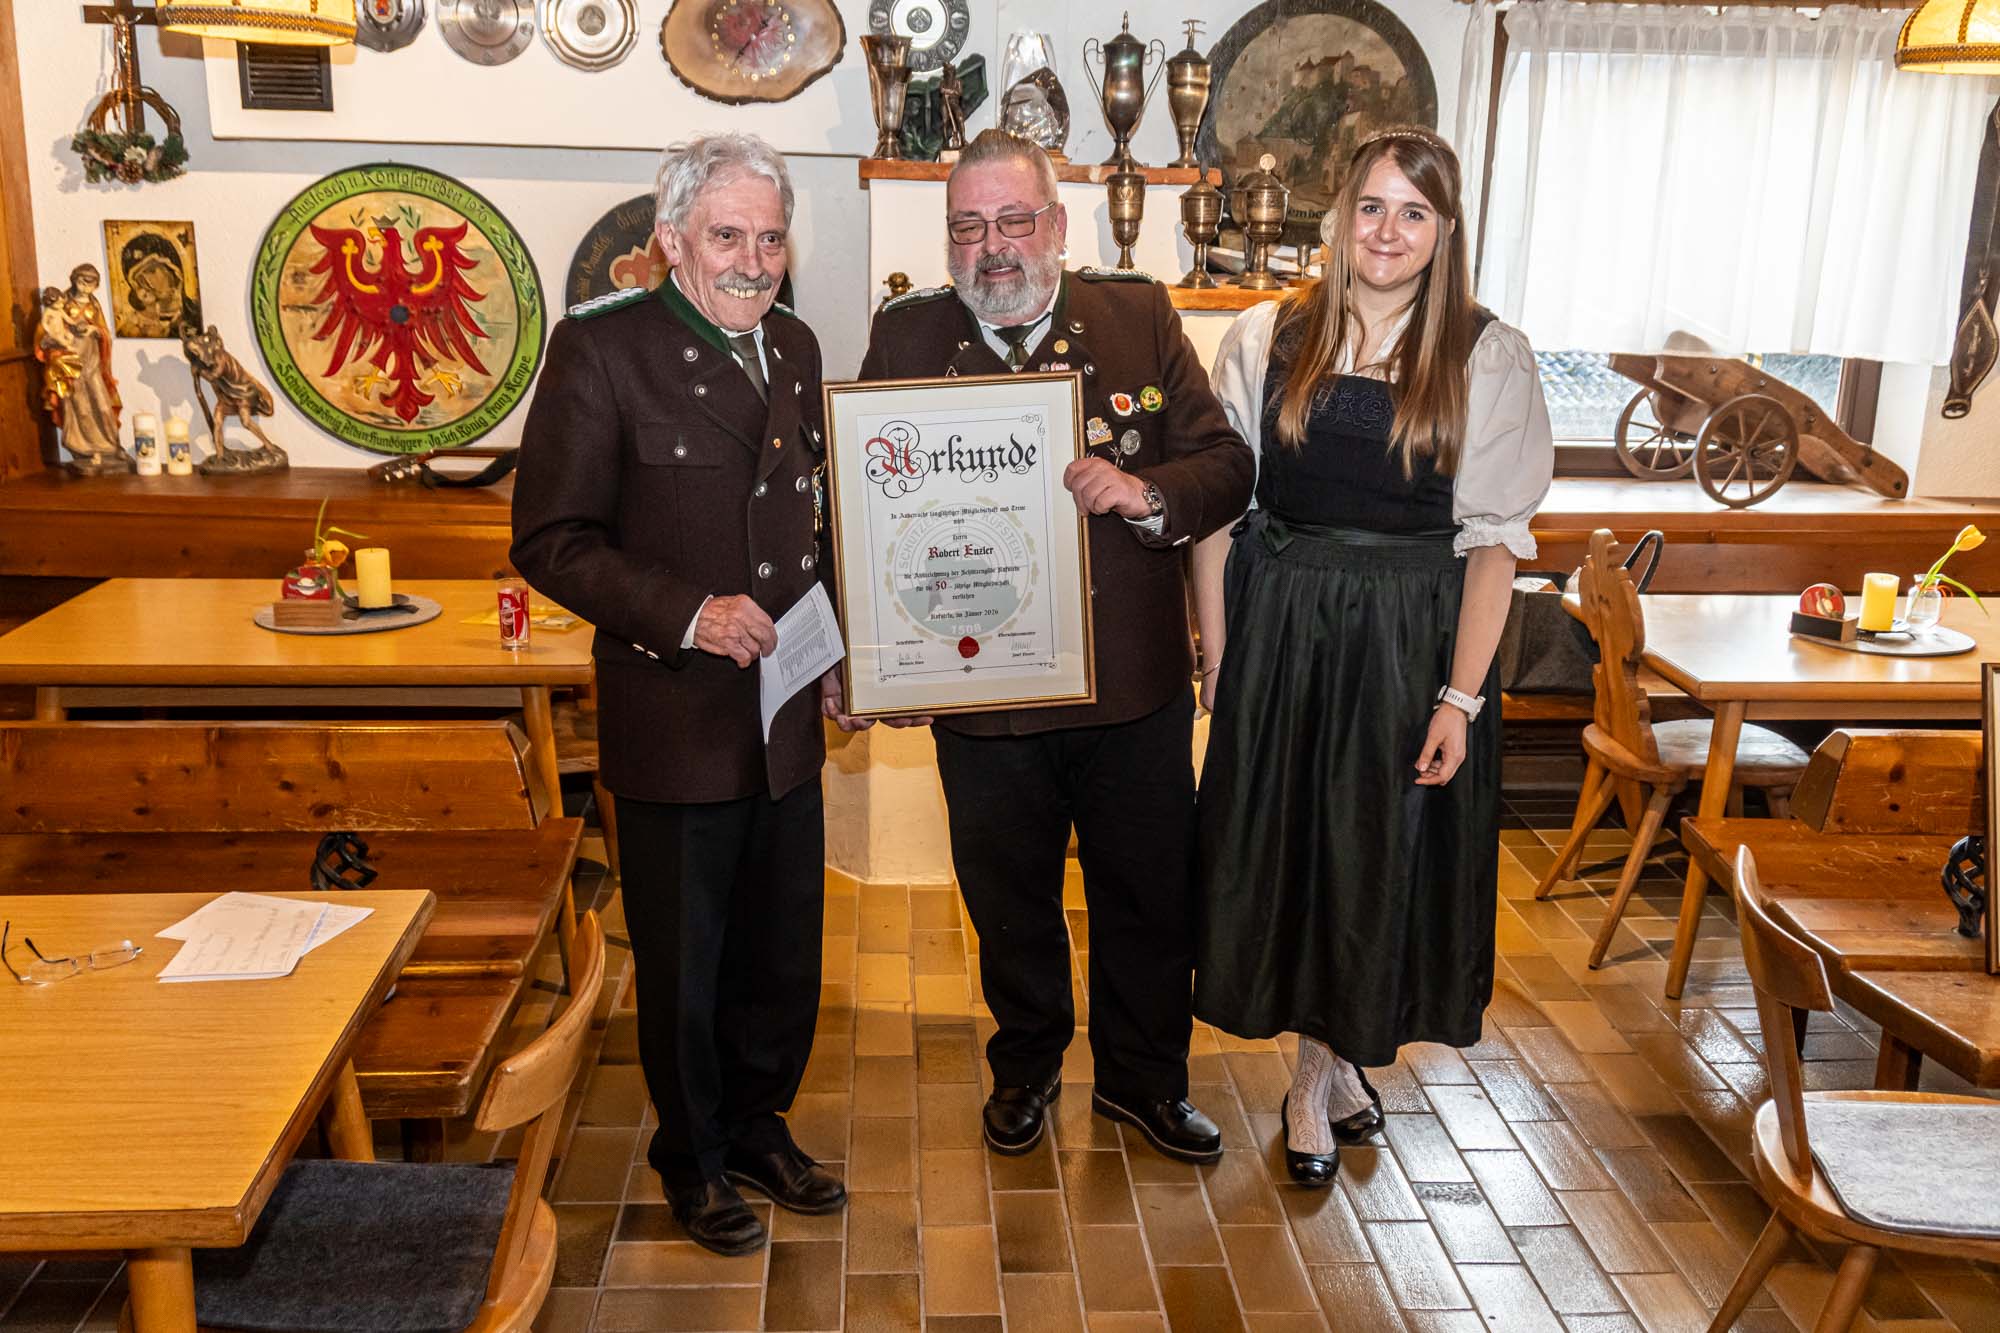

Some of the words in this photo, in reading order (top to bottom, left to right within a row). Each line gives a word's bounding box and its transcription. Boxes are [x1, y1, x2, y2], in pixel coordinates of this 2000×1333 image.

[484, 392, 513, 420] Franz
[866, 421, 1036, 498] Urkunde
[928, 546, 960, 560] Robert
[935, 580, 947, 591] 50
